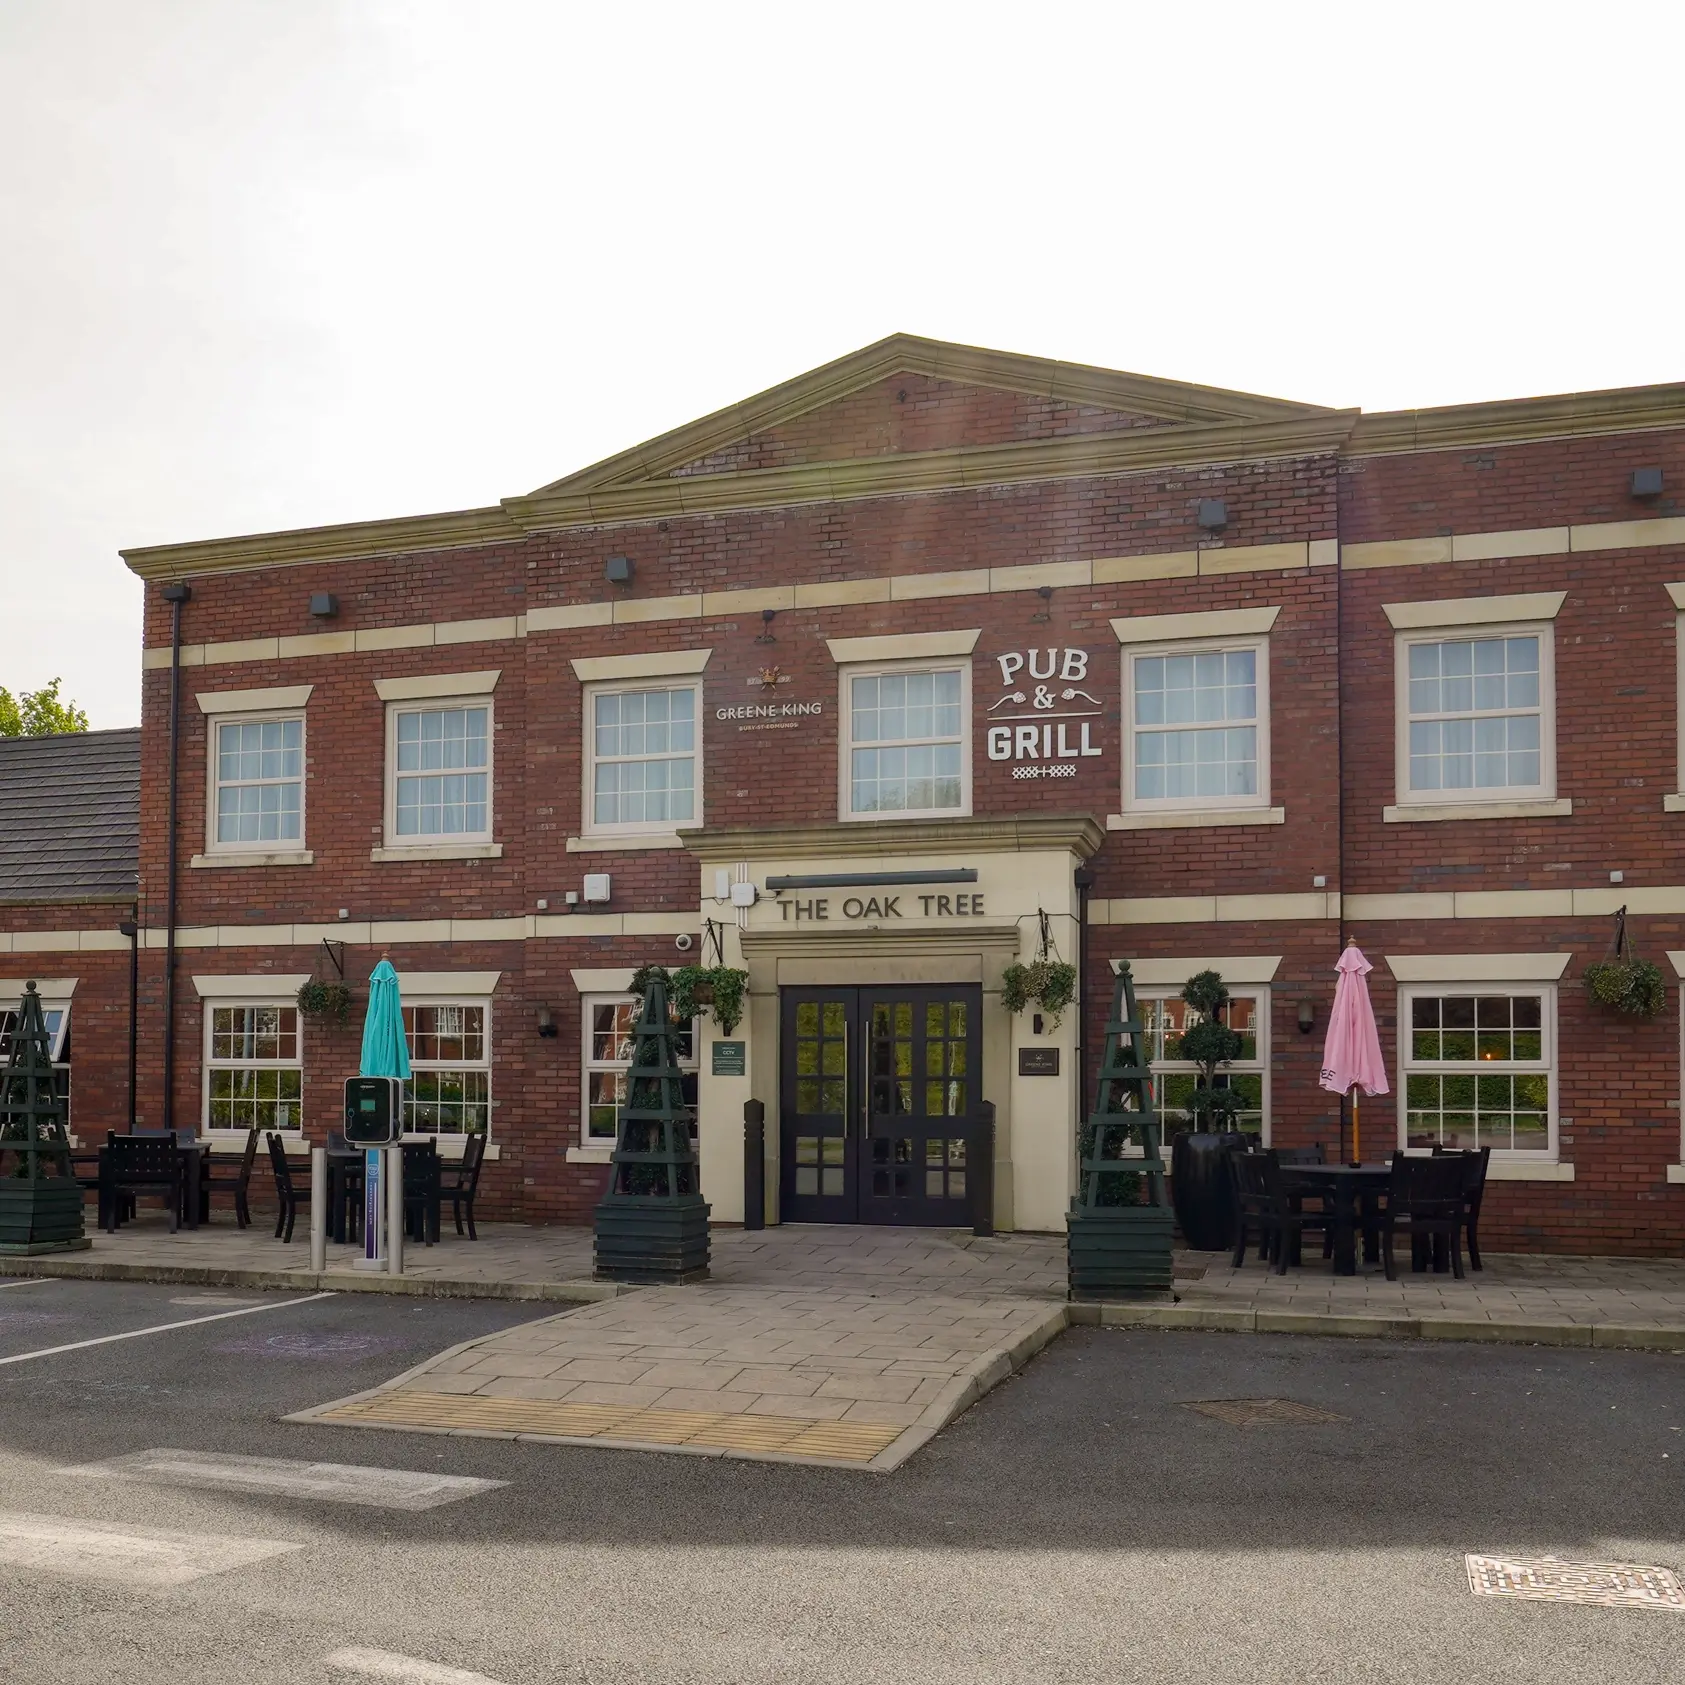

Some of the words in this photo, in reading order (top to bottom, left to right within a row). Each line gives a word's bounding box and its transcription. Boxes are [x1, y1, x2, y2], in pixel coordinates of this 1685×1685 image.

[997, 648, 1088, 686] PUB
[1033, 685, 1056, 709] &
[716, 705, 776, 720] GREENE
[782, 702, 822, 716] KING
[988, 722, 1102, 760] GRILL
[776, 899, 828, 920] THE
[842, 896, 902, 918] OAK
[918, 893, 985, 916] TREE
